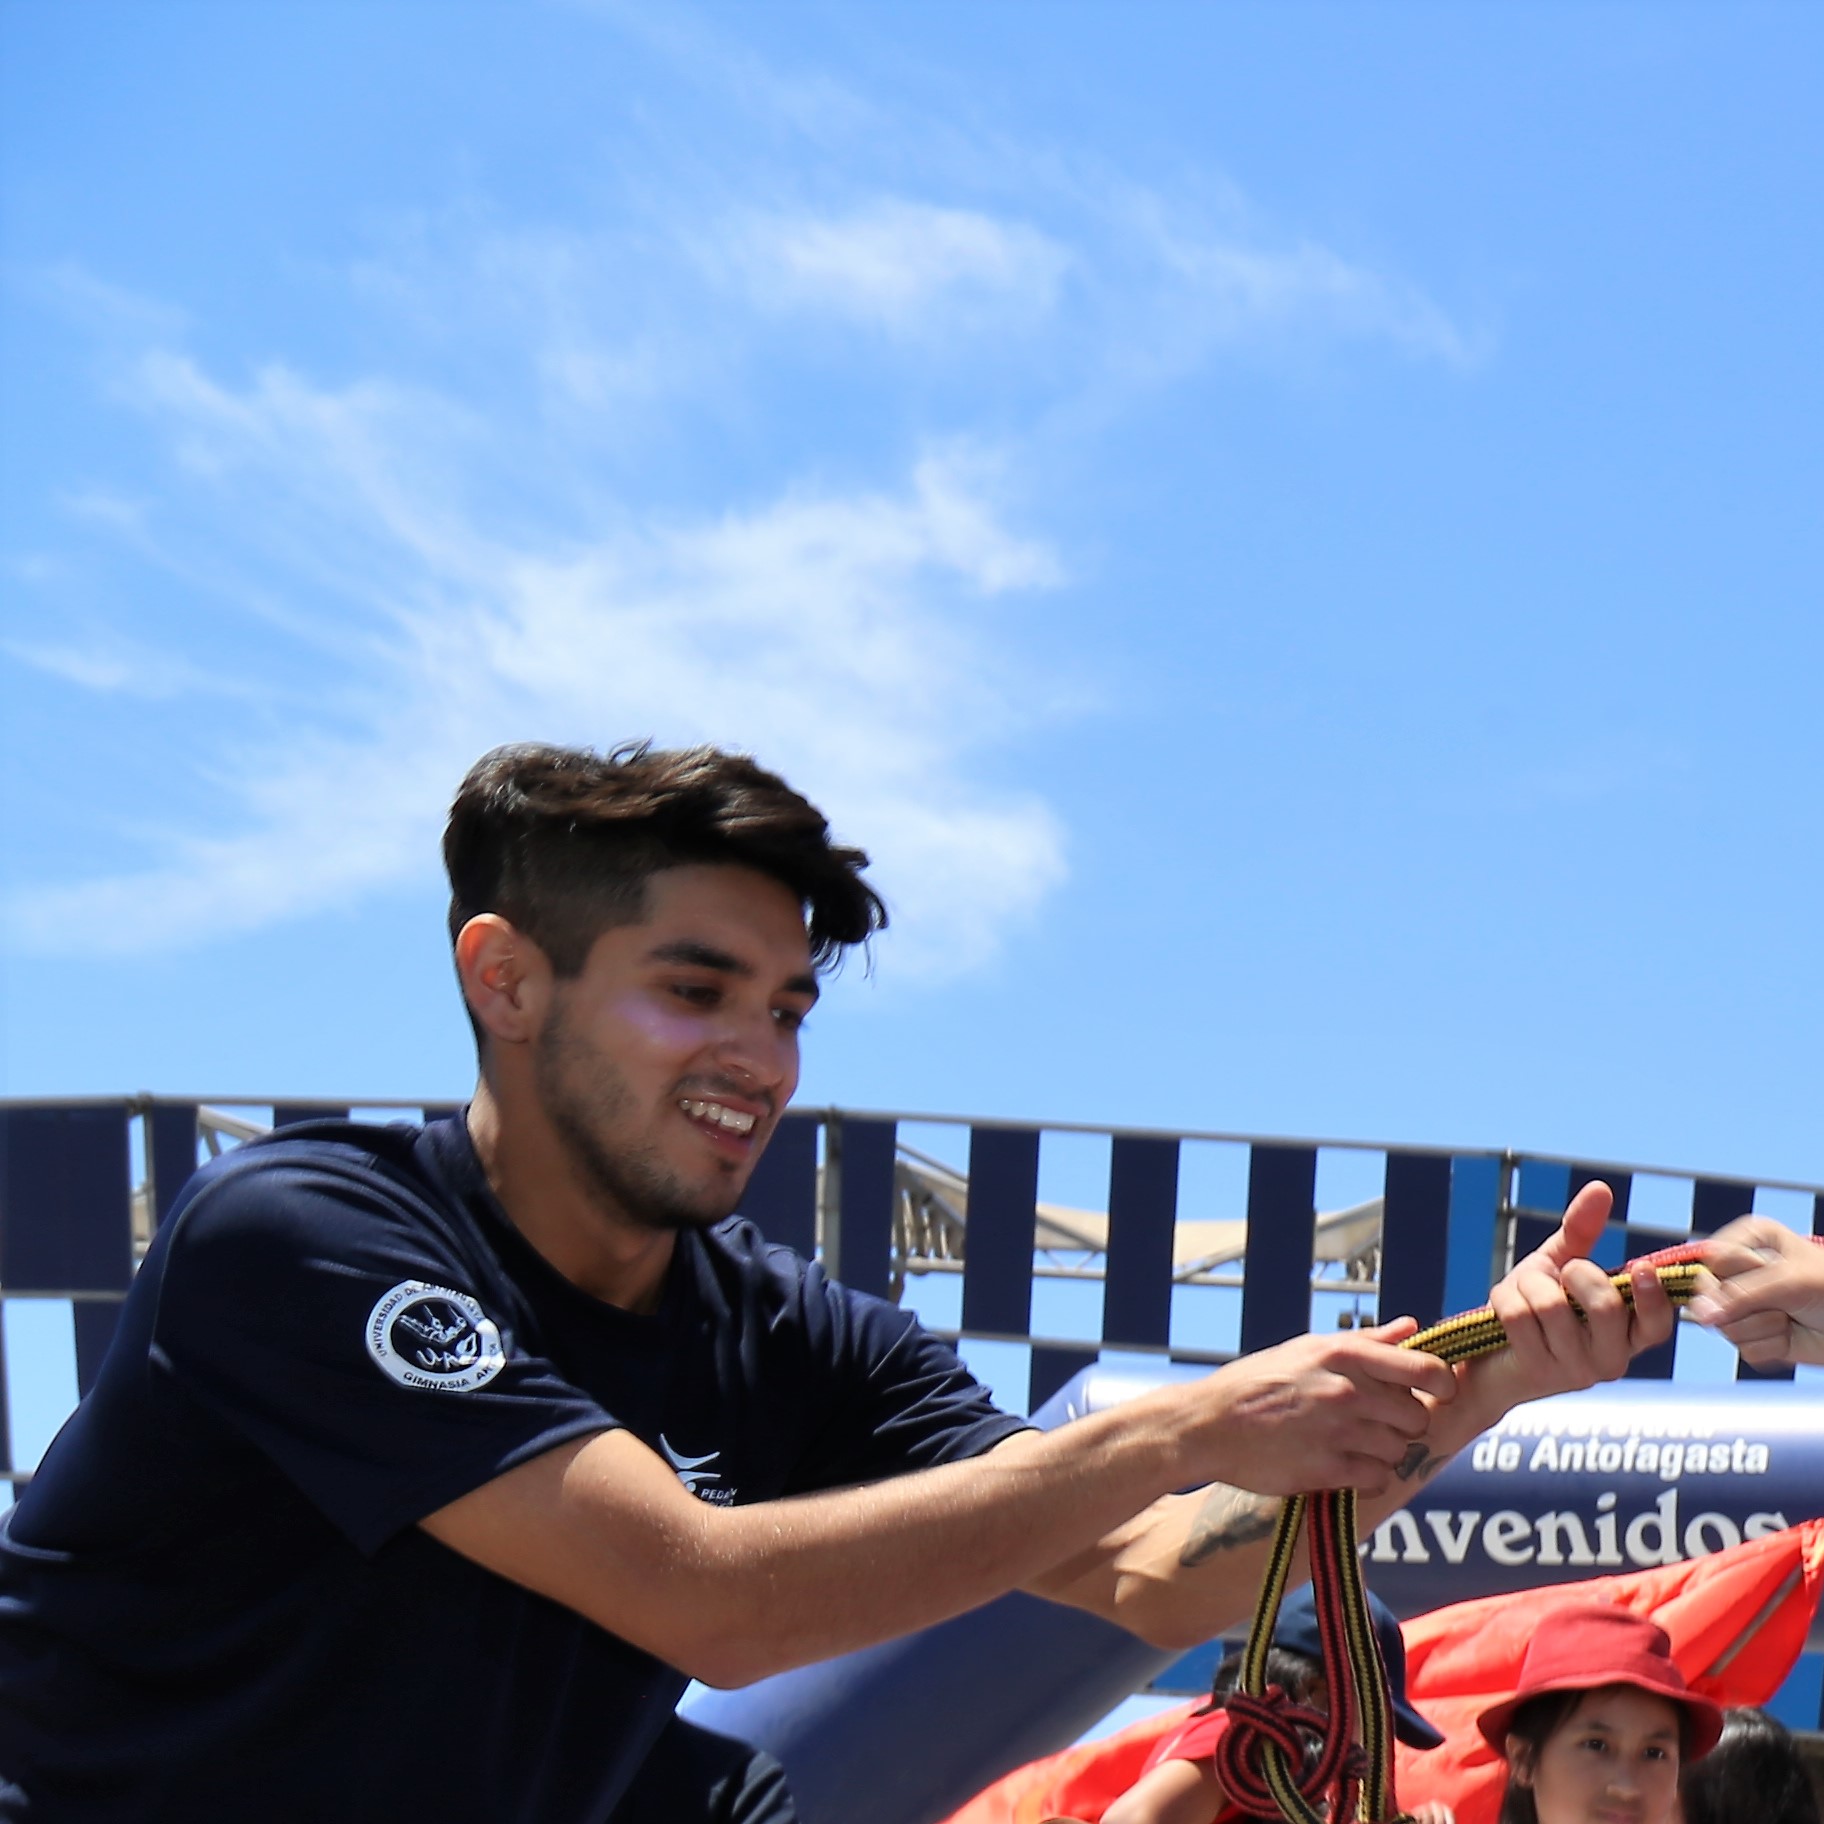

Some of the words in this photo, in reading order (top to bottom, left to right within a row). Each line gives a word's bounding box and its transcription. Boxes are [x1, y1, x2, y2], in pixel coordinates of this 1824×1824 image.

[371, 1293, 404, 1357] UNIVERSIDAD
[402, 1370, 471, 1390] GIMNASIA
[1472, 1438, 1518, 1471] de
[1531, 1438, 1770, 1481] Antofagasta
[1359, 1488, 1790, 1566] nvenido
